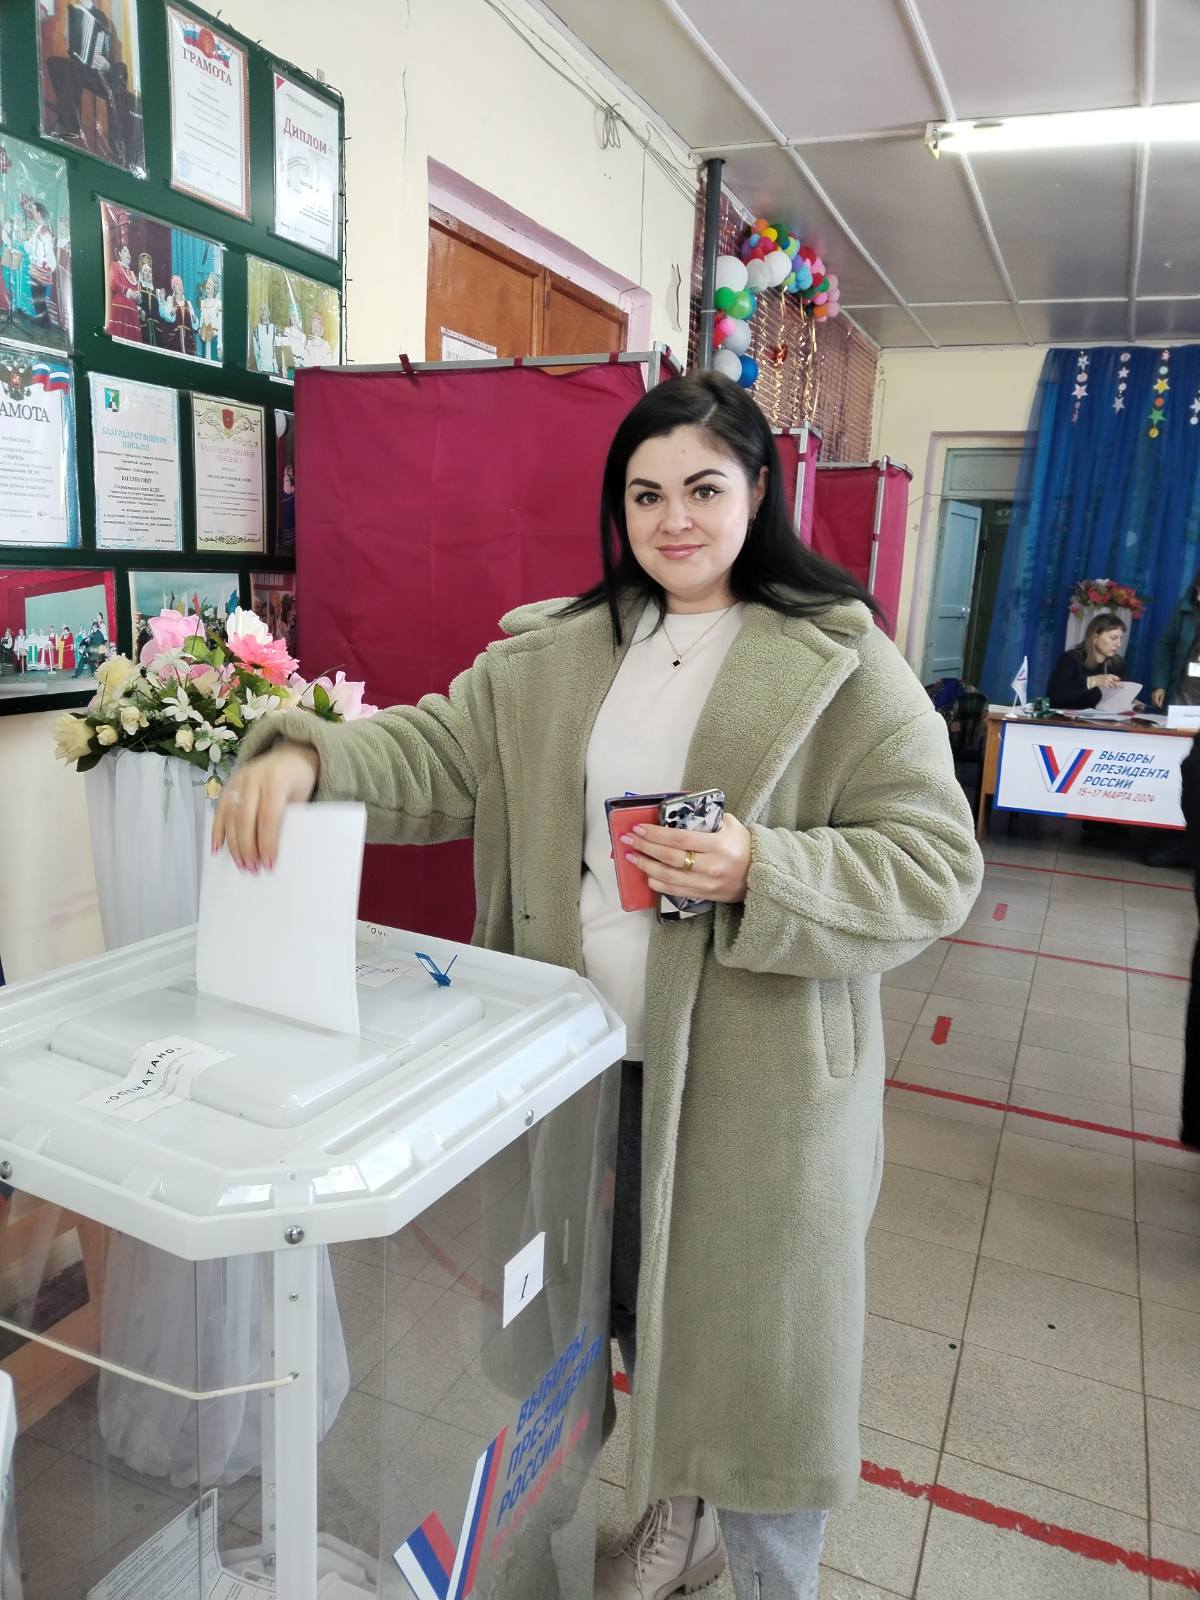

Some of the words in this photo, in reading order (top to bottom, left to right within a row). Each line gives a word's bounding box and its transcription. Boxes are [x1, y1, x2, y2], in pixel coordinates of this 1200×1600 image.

[182, 47, 233, 87] ГРАМОТА
[283, 117, 327, 154] Диплом
[1091, 763, 1170, 779] ПРЕЗИДЕНТА
[1099, 750, 1155, 764] ВЫБОРЫ
[1083, 775, 1134, 789] РОССИИ
[1101, 791, 1131, 801] МАРТА
[516, 1324, 587, 1436] ВЫБОРЫ
[506, 1331, 605, 1482] ПРЕЗИДЕНТА
[497, 1414, 566, 1529] РОССИИ
